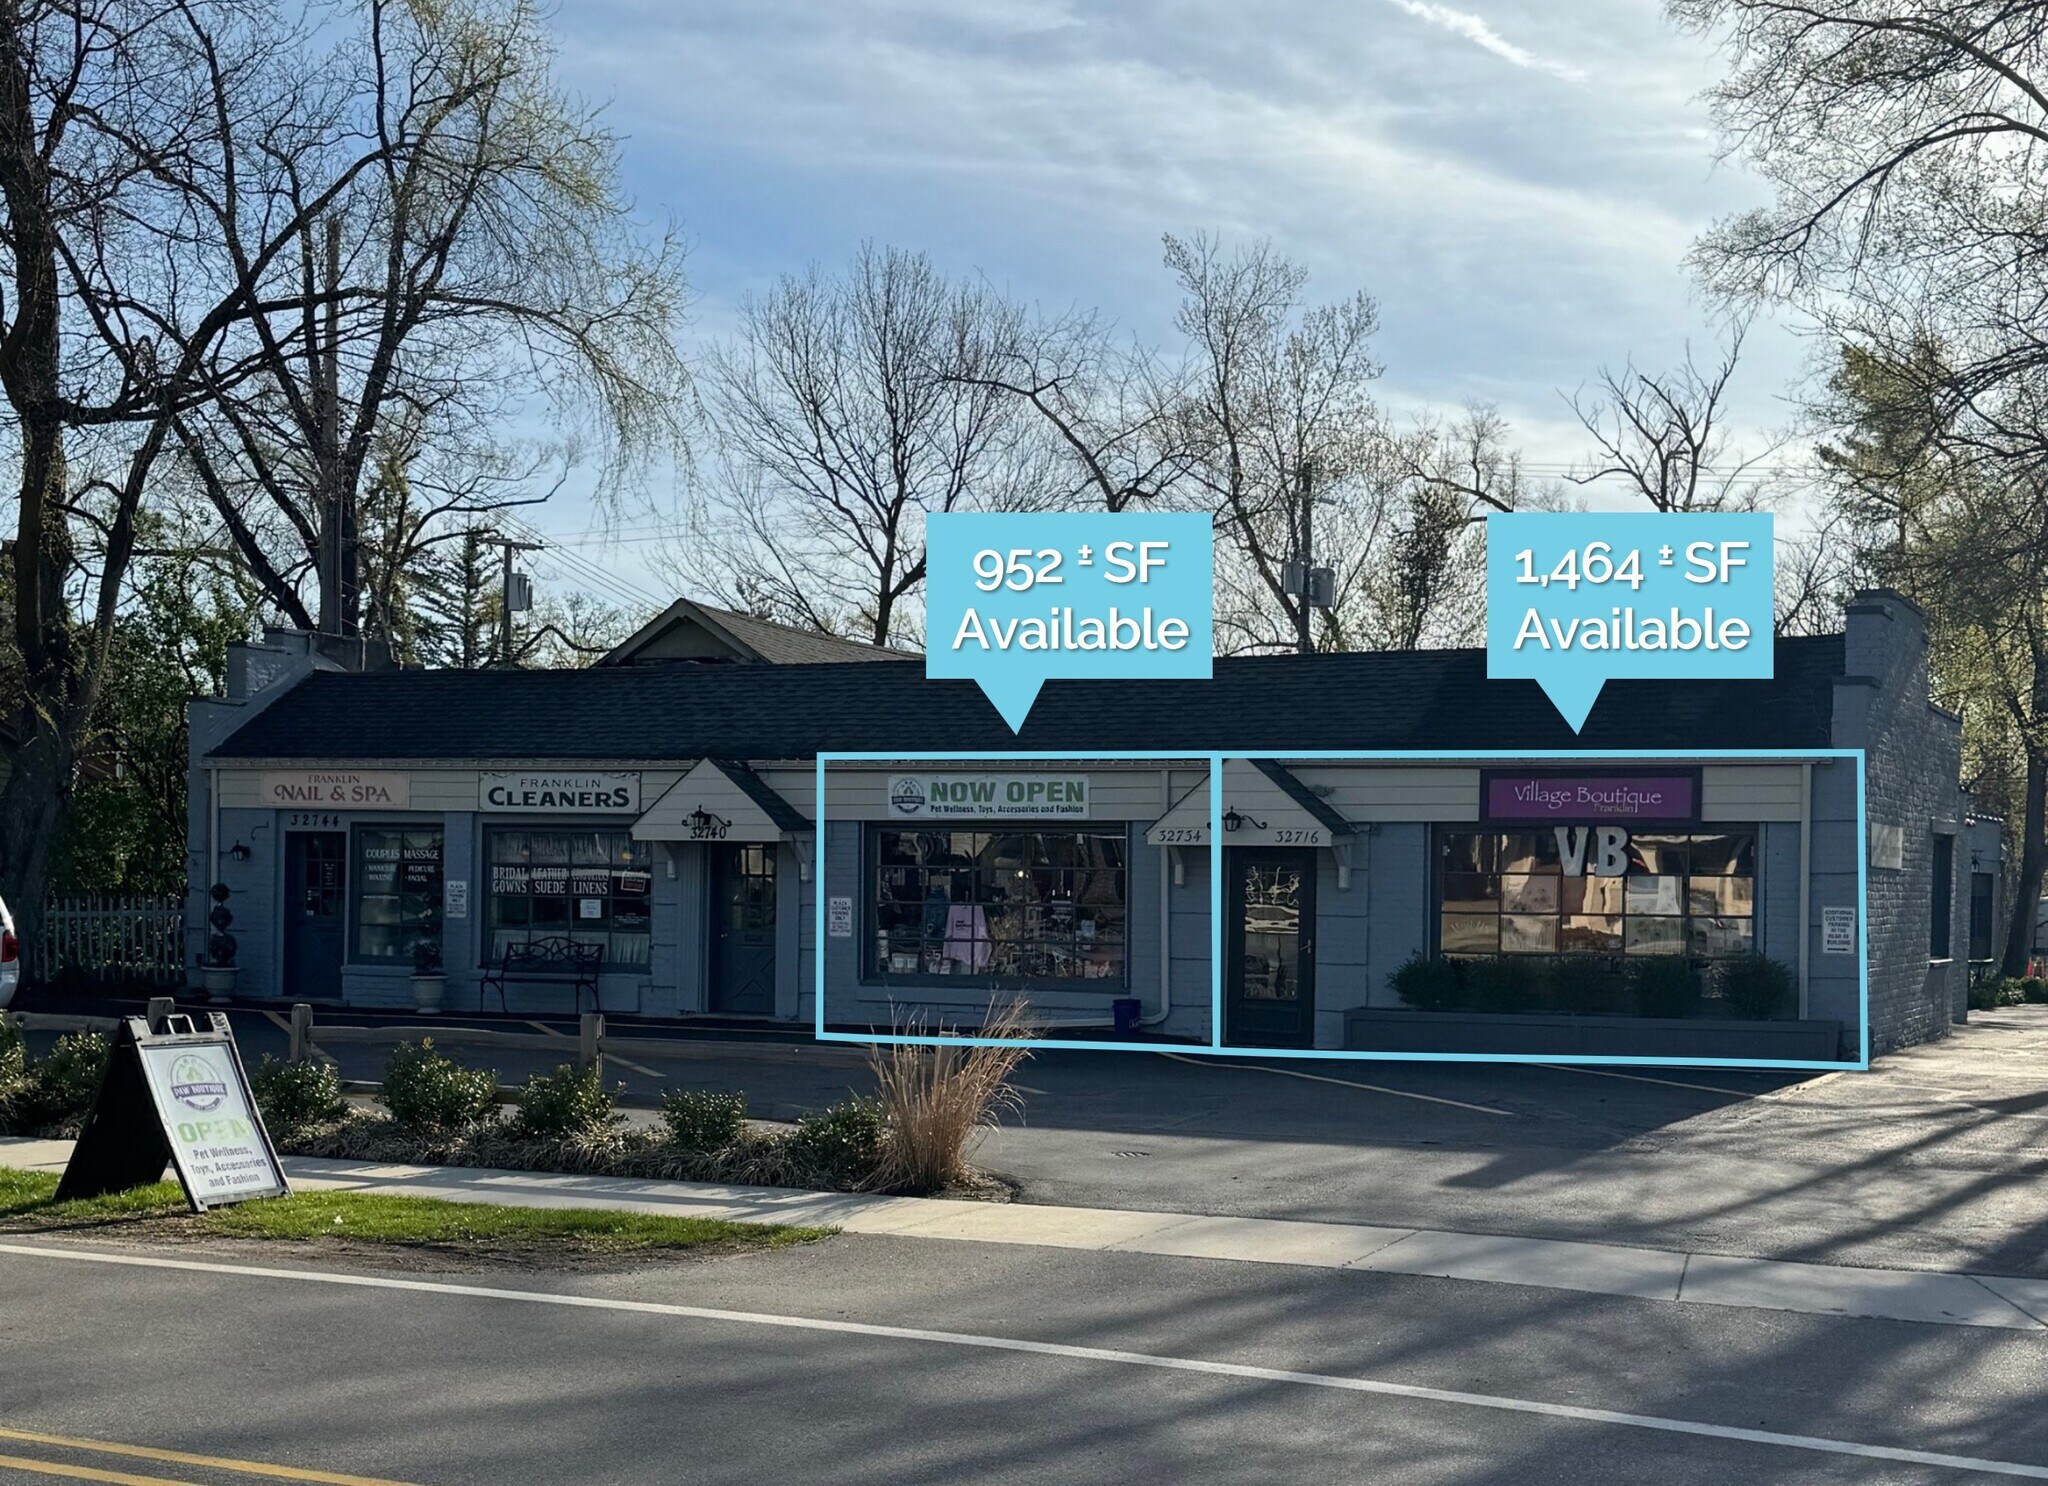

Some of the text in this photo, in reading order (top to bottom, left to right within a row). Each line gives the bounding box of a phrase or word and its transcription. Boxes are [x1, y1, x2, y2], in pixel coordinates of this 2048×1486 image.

[308, 774, 360, 783] FRANKLIN
[520, 778, 601, 788] FRANKLIN
[274, 784, 391, 802] NAIL & SPA
[488, 787, 630, 808] CLEANERS
[930, 781, 1084, 802] NOW OPEN
[1514, 780, 1663, 813] Village Boutique
[930, 804, 1084, 814] Pet Wellness, Toys, Accessories and Fashion
[1593, 803, 1634, 813] Franklin
[290, 814, 339, 827] 32744
[690, 825, 727, 839] 32740
[1274, 830, 1319, 844] 32716
[365, 848, 440, 860] COUPLES MASSAGE
[1554, 826, 1628, 876] VB
[493, 867, 528, 880] BRIDAL
[533, 867, 568, 880] LEATHER
[492, 880, 527, 894] GOWNS
[534, 880, 566, 894] SUEDE
[573, 881, 608, 895] LINENS
[173, 1086, 190, 1097] PAW
[177, 1119, 250, 1143] OPEN
[192, 1146, 253, 1160] Pet Wellness,
[190, 1158, 267, 1175] Toys, Accessories
[208, 1173, 261, 1187] and Fashion
